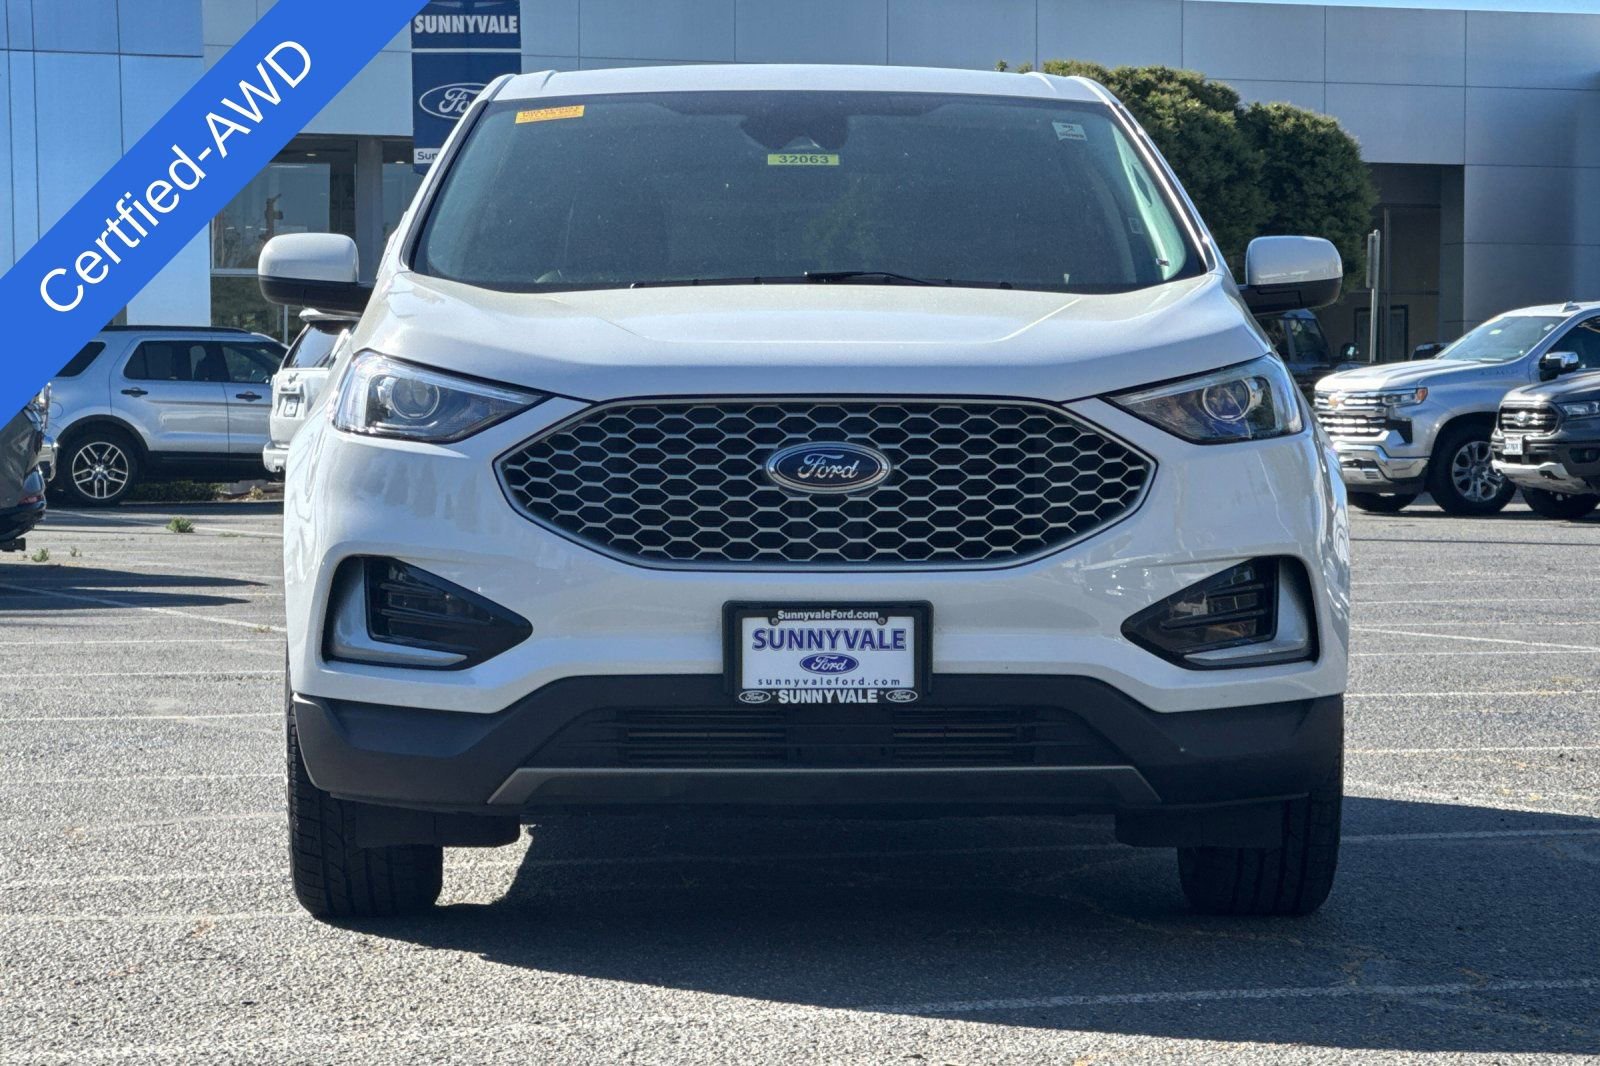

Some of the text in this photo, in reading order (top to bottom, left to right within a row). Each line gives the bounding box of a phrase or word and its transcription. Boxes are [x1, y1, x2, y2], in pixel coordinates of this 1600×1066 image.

[414, 15, 518, 34] SUNNYVALE
[778, 155, 829, 164] 32063
[797, 453, 860, 479] Ford
[777, 610, 879, 621] SunnyvaleFord.com
[752, 628, 906, 650] SUNNYVALE
[811, 655, 847, 671] Ford
[758, 676, 900, 687] sunnyvaleford.com
[744, 692, 765, 701] Ford
[777, 689, 879, 704] SUNNYVALE
[891, 691, 912, 701] Ford
